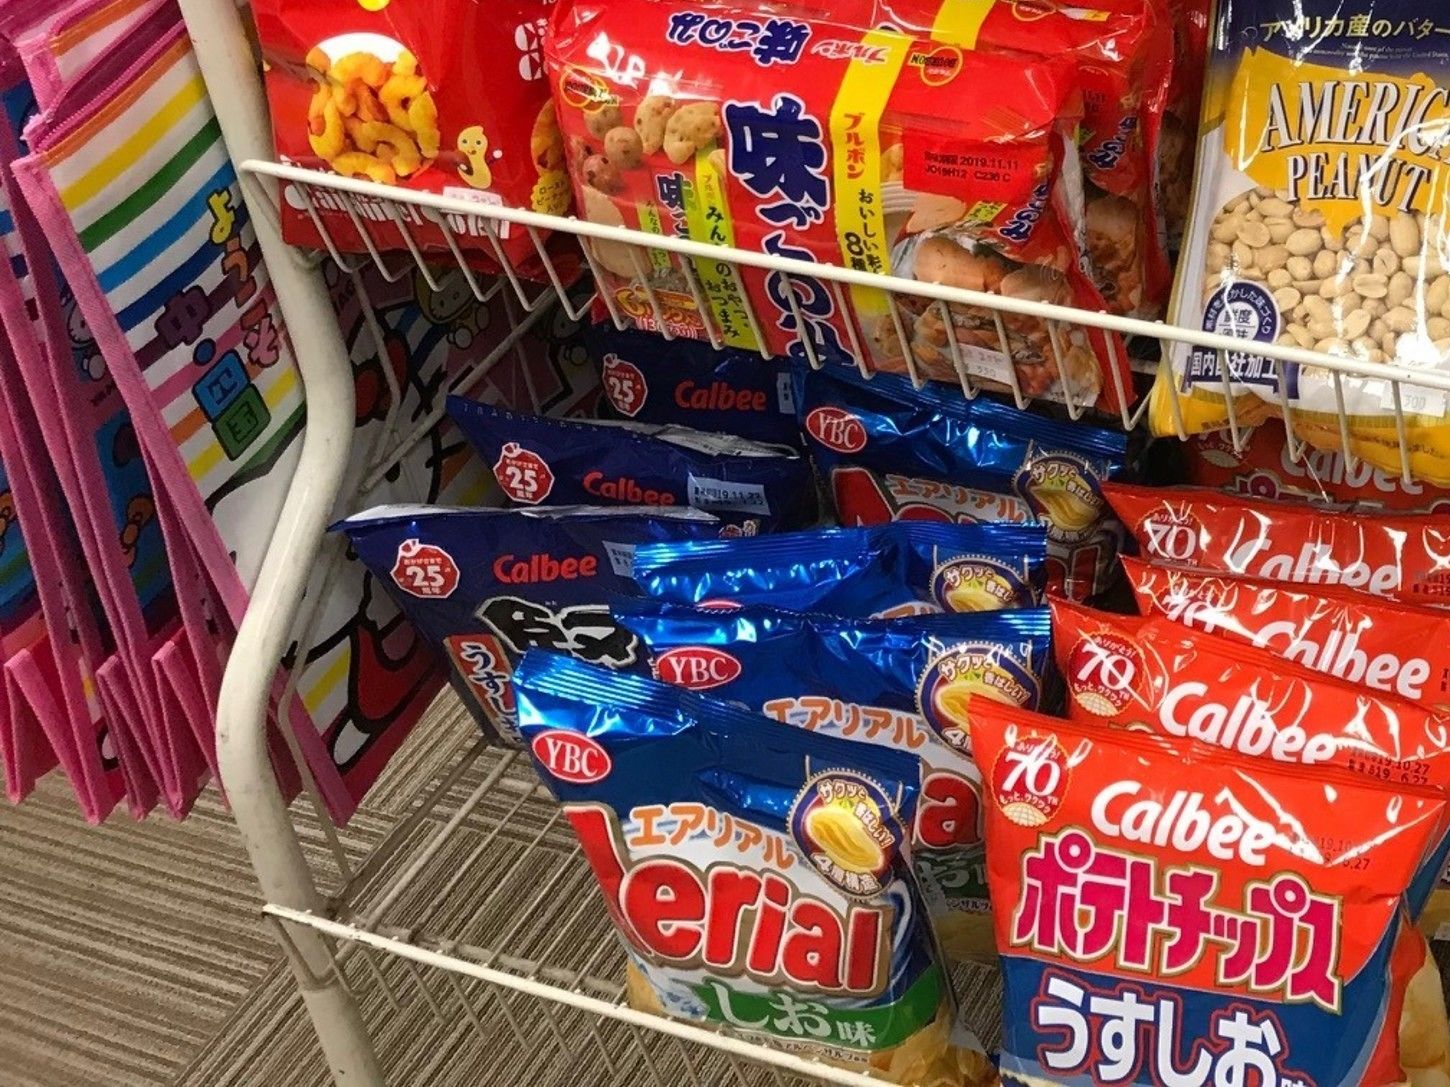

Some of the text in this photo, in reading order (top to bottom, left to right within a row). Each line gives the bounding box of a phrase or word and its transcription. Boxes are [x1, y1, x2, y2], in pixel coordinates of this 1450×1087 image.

[668, 13, 889, 64] 味ごのみ ブルボン
[843, 112, 867, 179] ブルボン
[959, 154, 1019, 170] 2019.11.11
[1286, 150, 1433, 212] PEANUT
[1190, 351, 1279, 379] 国内社加工
[608, 378, 636, 404] 25
[674, 379, 767, 413] Calbee
[818, 412, 860, 447] YBC
[505, 467, 539, 492] 25
[582, 470, 676, 508] Calbee
[887, 474, 1027, 524] エアリアル
[405, 565, 446, 588] 25
[493, 553, 598, 585] Calbee
[672, 656, 728, 684] YBC
[1076, 642, 1134, 691] 70
[765, 697, 926, 749] エアリアル
[1158, 682, 1338, 766] Calbee
[544, 738, 598, 776] YBC
[1001, 750, 1061, 797] 70
[818, 780, 867, 804] サクッと
[629, 803, 796, 869] エアリアル
[1090, 780, 1278, 867] Calbee
[1010, 829, 1342, 1014] ポテトチップス
[712, 981, 878, 1047] しお味
